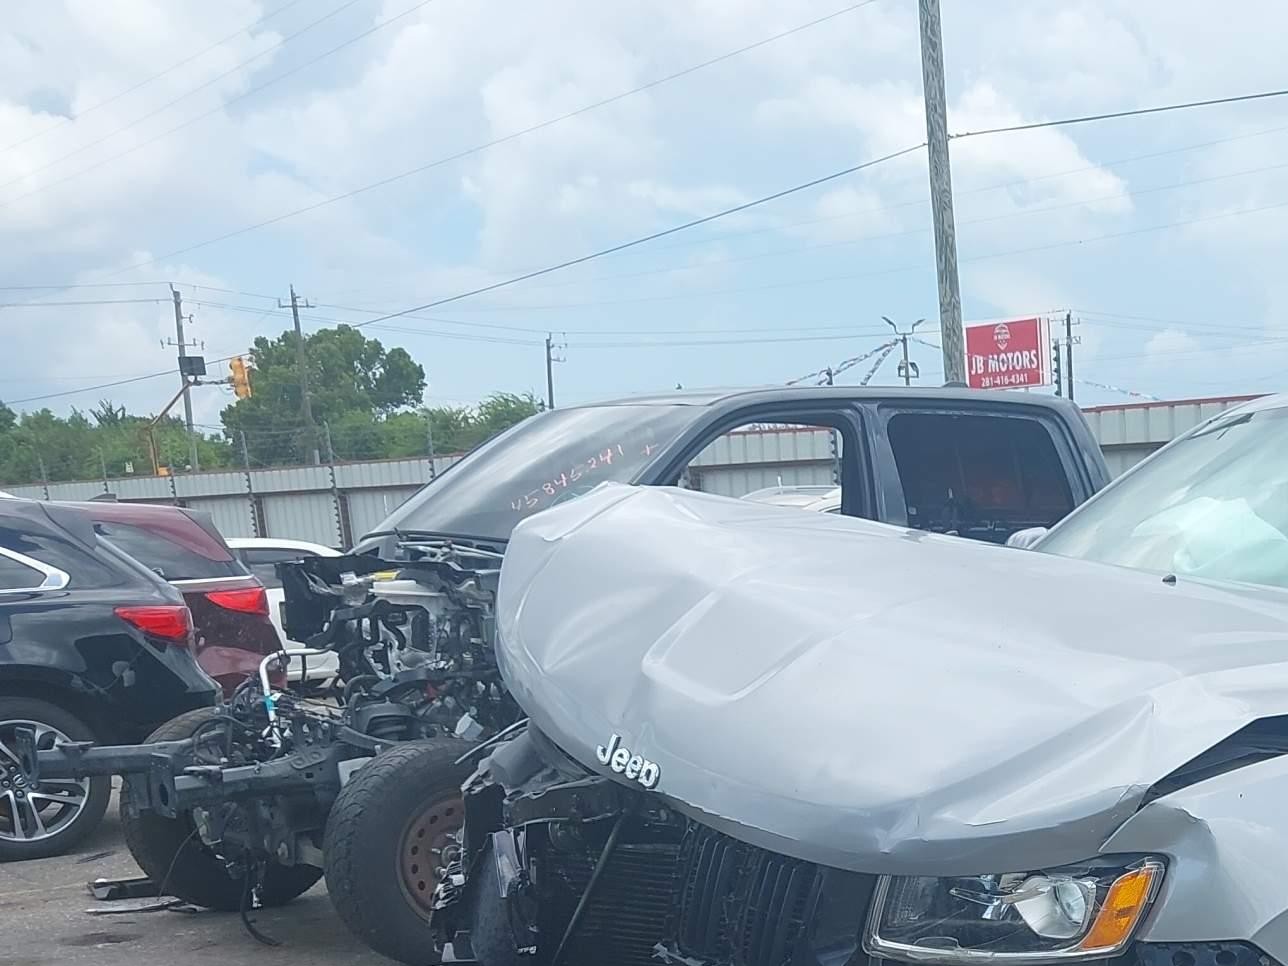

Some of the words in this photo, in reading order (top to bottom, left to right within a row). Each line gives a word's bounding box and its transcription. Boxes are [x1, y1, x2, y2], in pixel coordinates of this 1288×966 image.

[971, 354, 984, 375] JB
[988, 349, 1037, 373] MOTORS
[596, 734, 660, 789] Jeep
